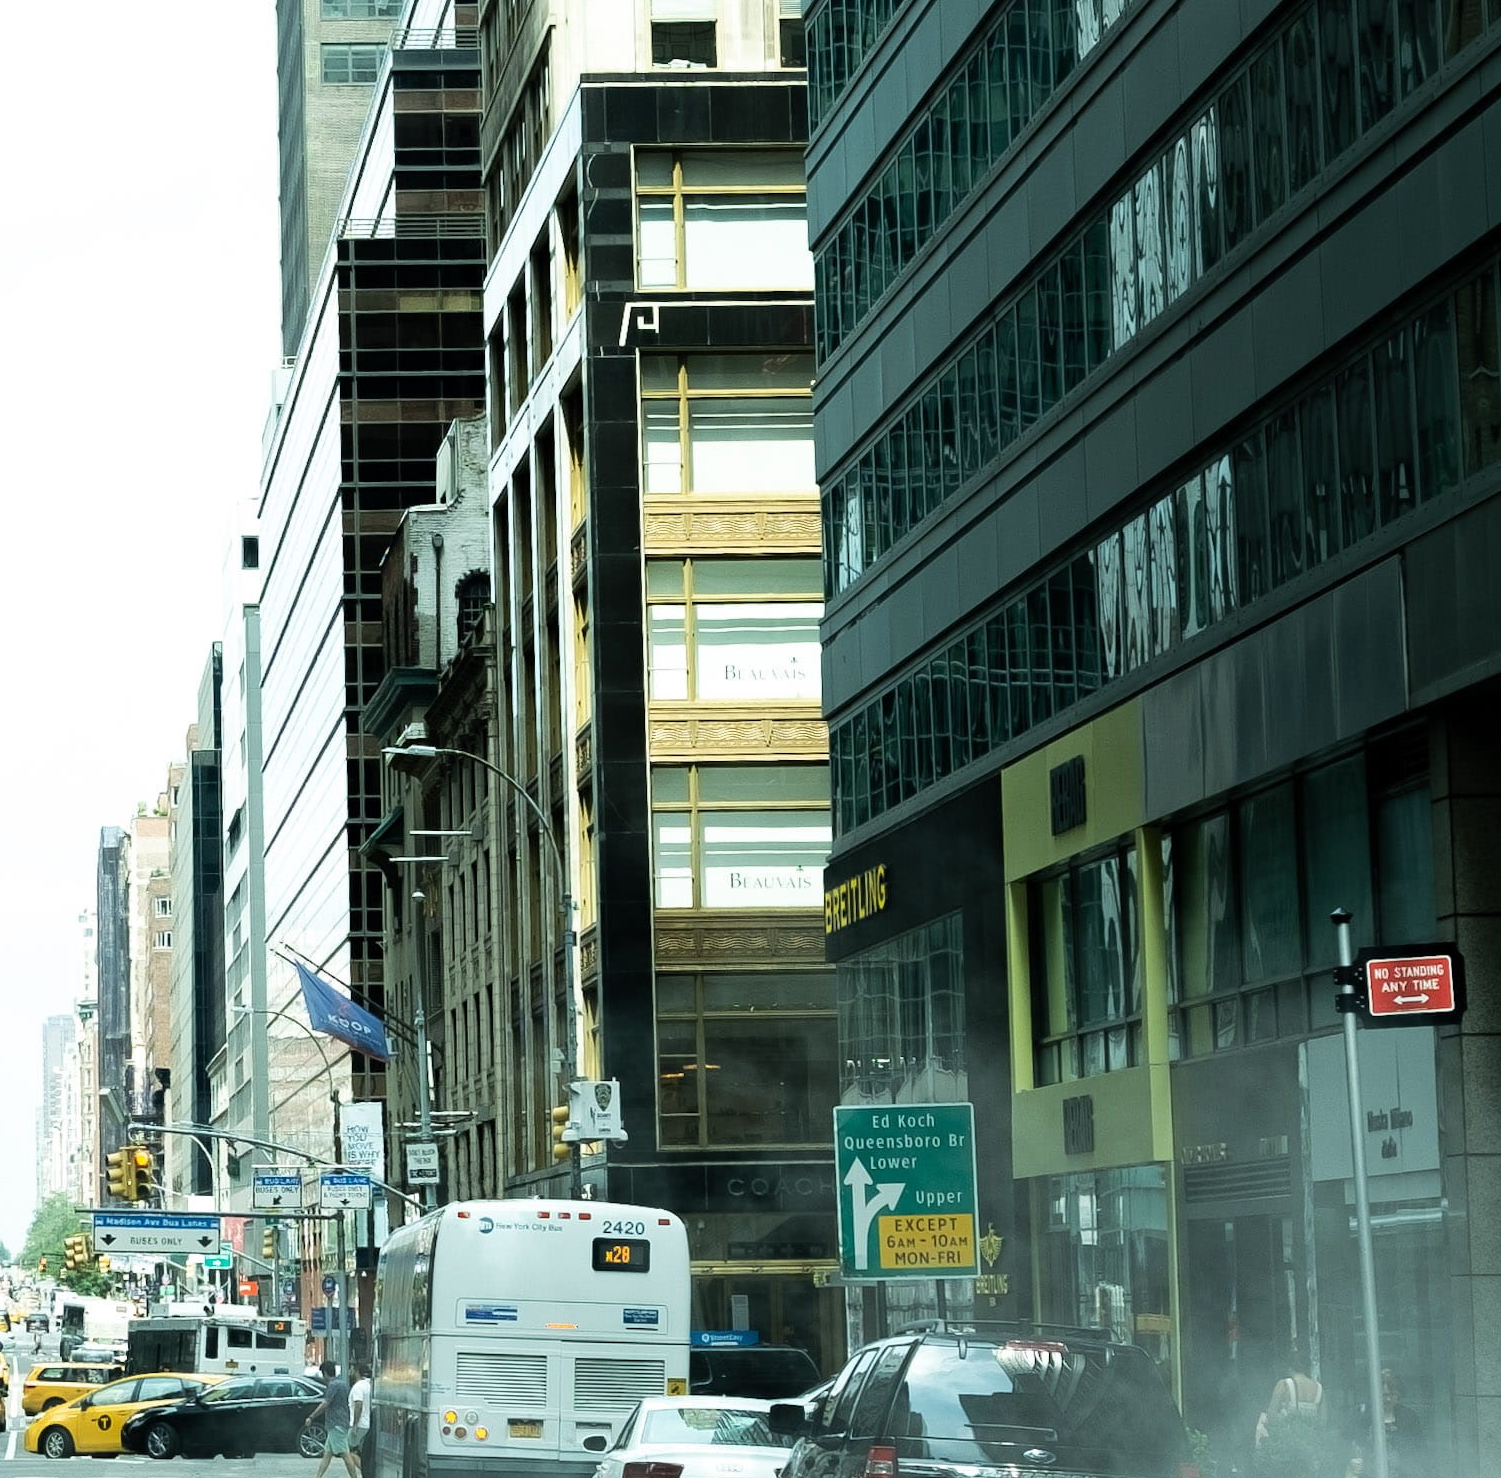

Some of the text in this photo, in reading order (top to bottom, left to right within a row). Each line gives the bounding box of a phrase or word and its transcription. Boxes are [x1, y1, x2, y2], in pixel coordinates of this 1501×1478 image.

[730, 872, 812, 889] BEAUVAIS
[825, 863, 887, 935] BREITLING
[1374, 964, 1444, 979] NO STANDING
[1381, 978, 1440, 993] ANY TIME
[872, 1113, 935, 1129] Ed Koch
[844, 1133, 965, 1151] Queensboro Br
[870, 1155, 917, 1170] Lower
[727, 1177, 836, 1196] COACH
[915, 1190, 963, 1207] Upper
[532, 1223, 547, 1232] City
[548, 1224, 563, 1232] Bus
[602, 1221, 645, 1235] 2420
[895, 1217, 957, 1232] EXCEPT
[130, 1236, 182, 1246] BUSES ONLY
[886, 1235, 916, 1249] 6AM
[931, 1234, 968, 1248] 10AM
[895, 1250, 961, 1265] MON-FRI
